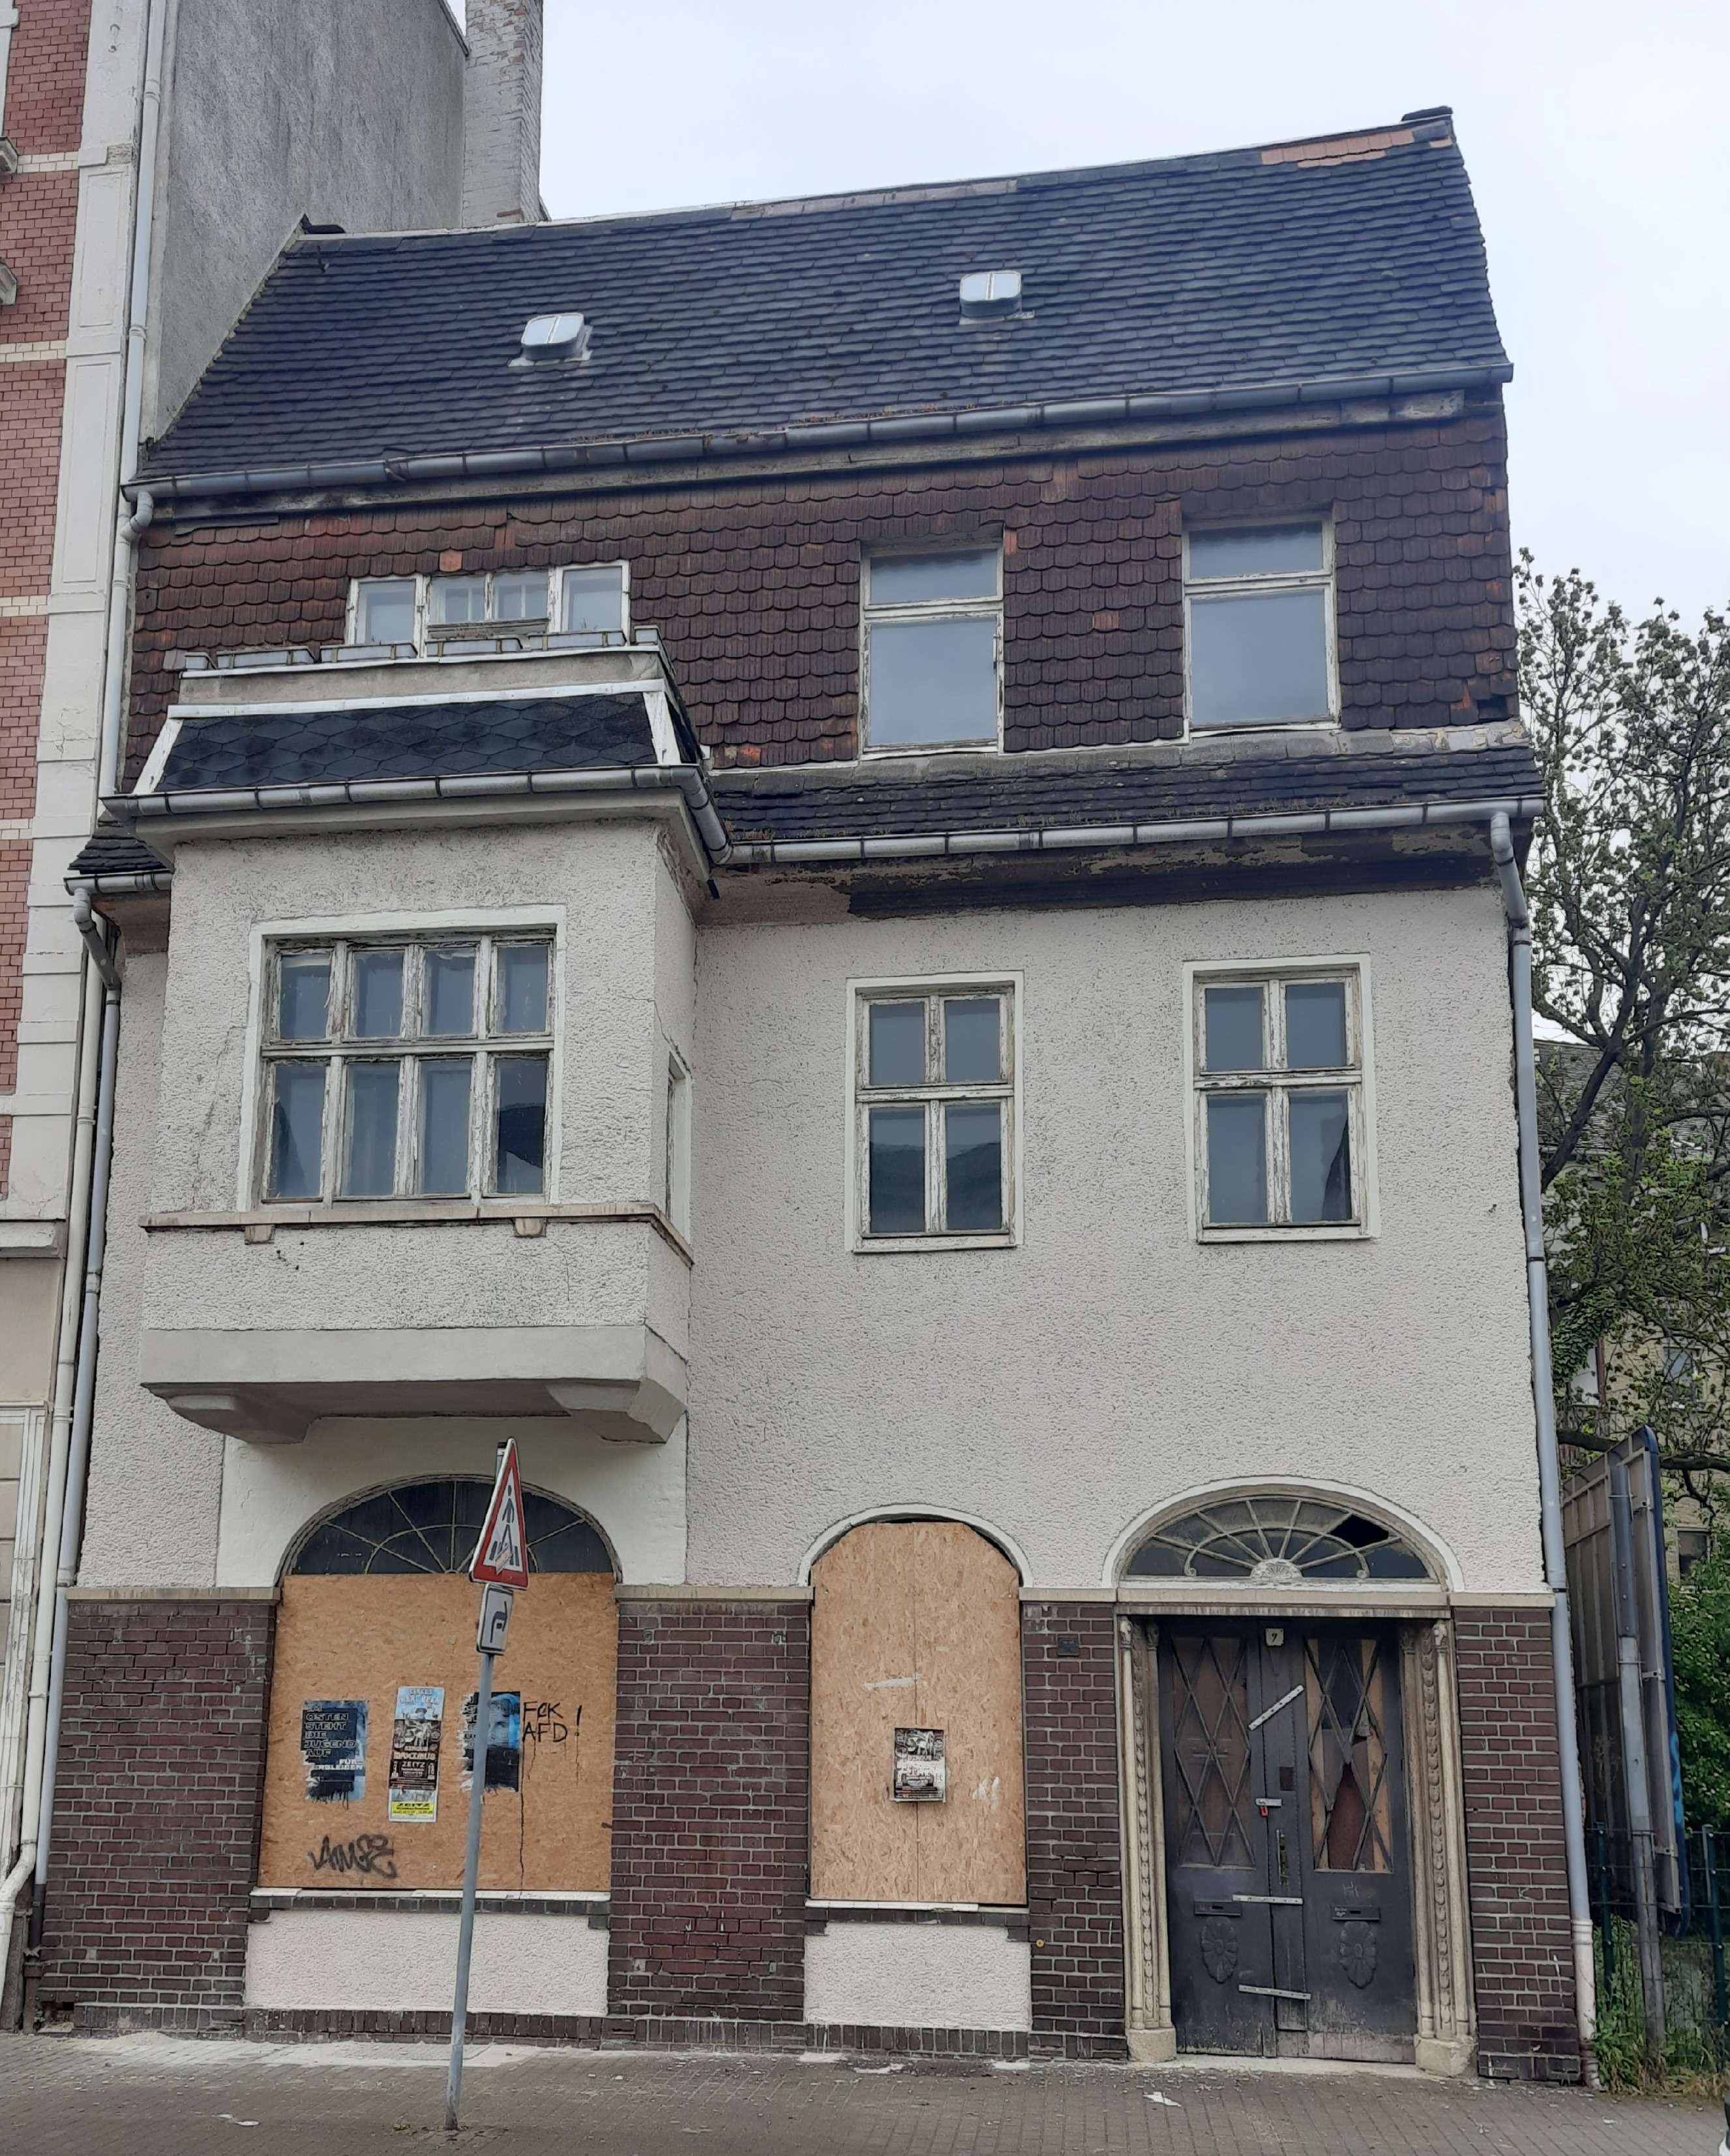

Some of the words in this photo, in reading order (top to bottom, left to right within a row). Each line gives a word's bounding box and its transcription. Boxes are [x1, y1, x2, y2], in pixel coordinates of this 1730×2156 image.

[1272, 1633, 1278, 1642] 7
[523, 1701, 563, 1722] FCK
[306, 1713, 349, 1721] OSTEN
[305, 1722, 346, 1730] STEHT
[305, 1731, 327, 1739] DIE
[522, 1722, 568, 1743] AFD
[304, 1739, 356, 1748] JUGEND
[306, 1748, 331, 1758] AUF
